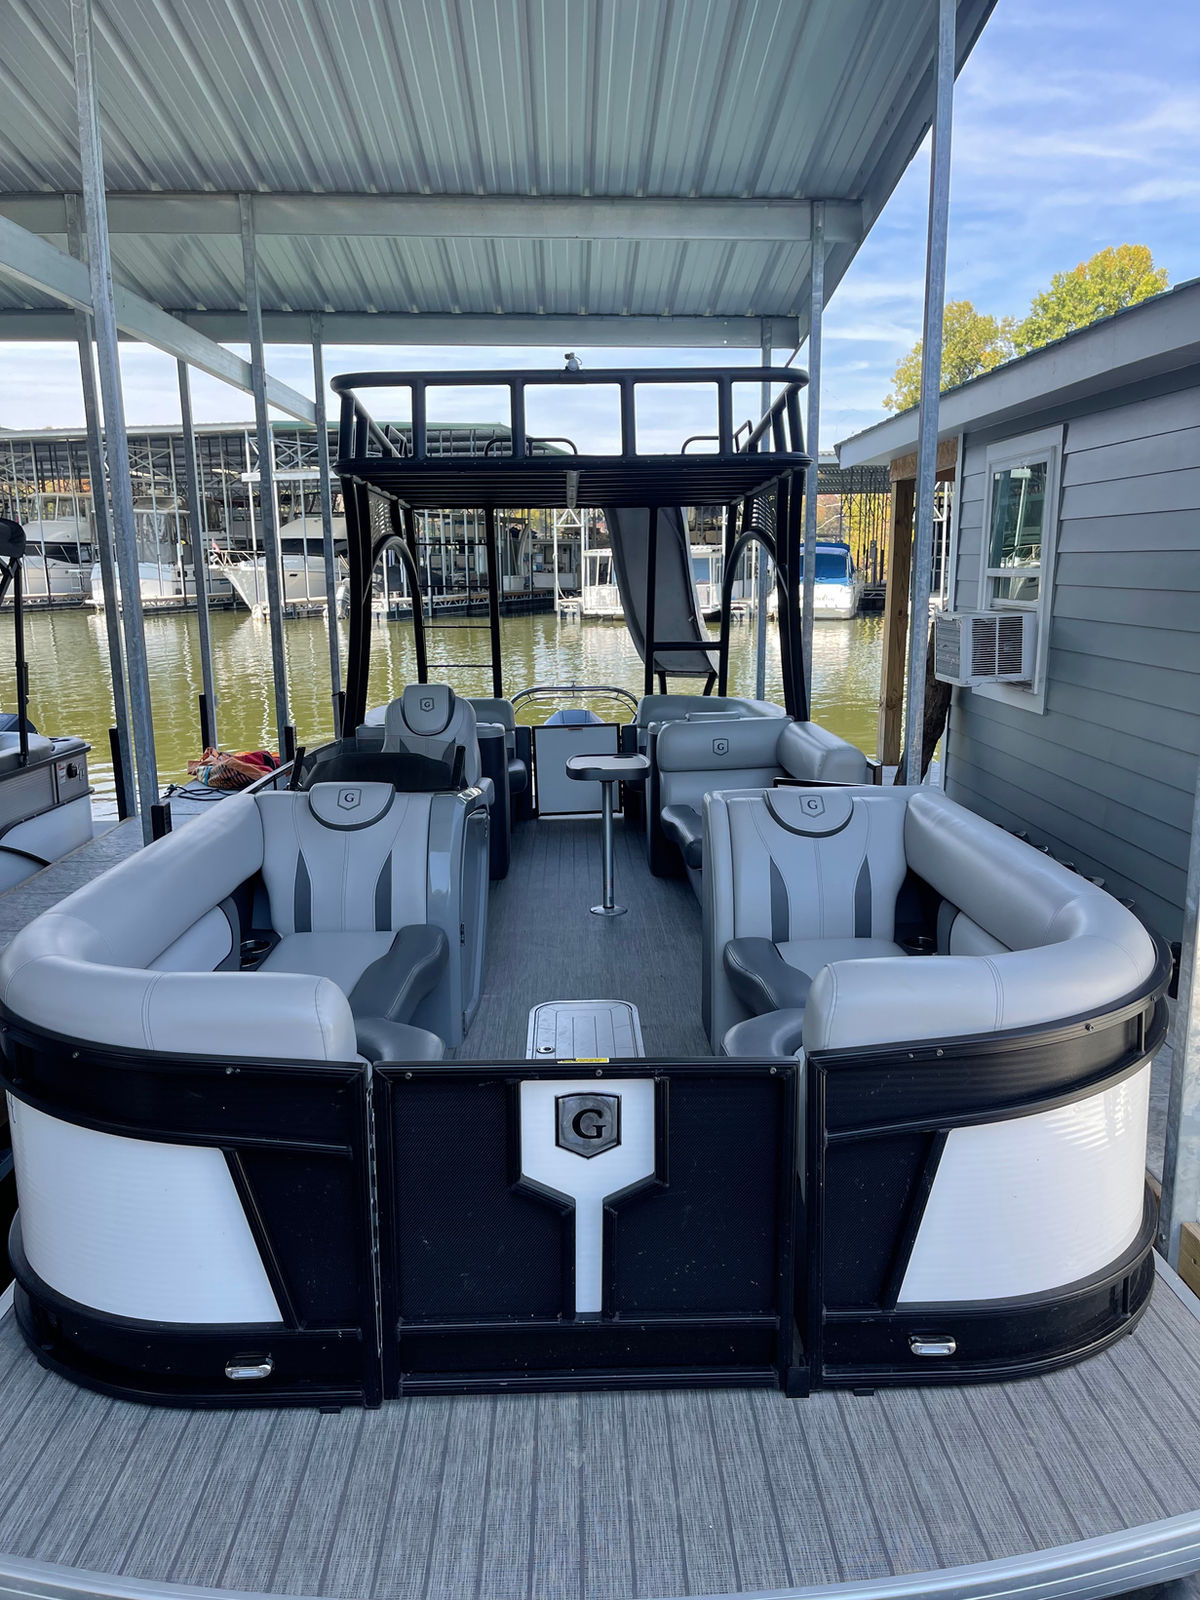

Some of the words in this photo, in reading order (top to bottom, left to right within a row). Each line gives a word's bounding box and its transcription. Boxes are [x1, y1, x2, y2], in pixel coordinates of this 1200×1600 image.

[717, 742, 725, 751] G
[344, 792, 355, 803] G
[807, 799, 818, 810] G
[572, 1108, 607, 1140] G
